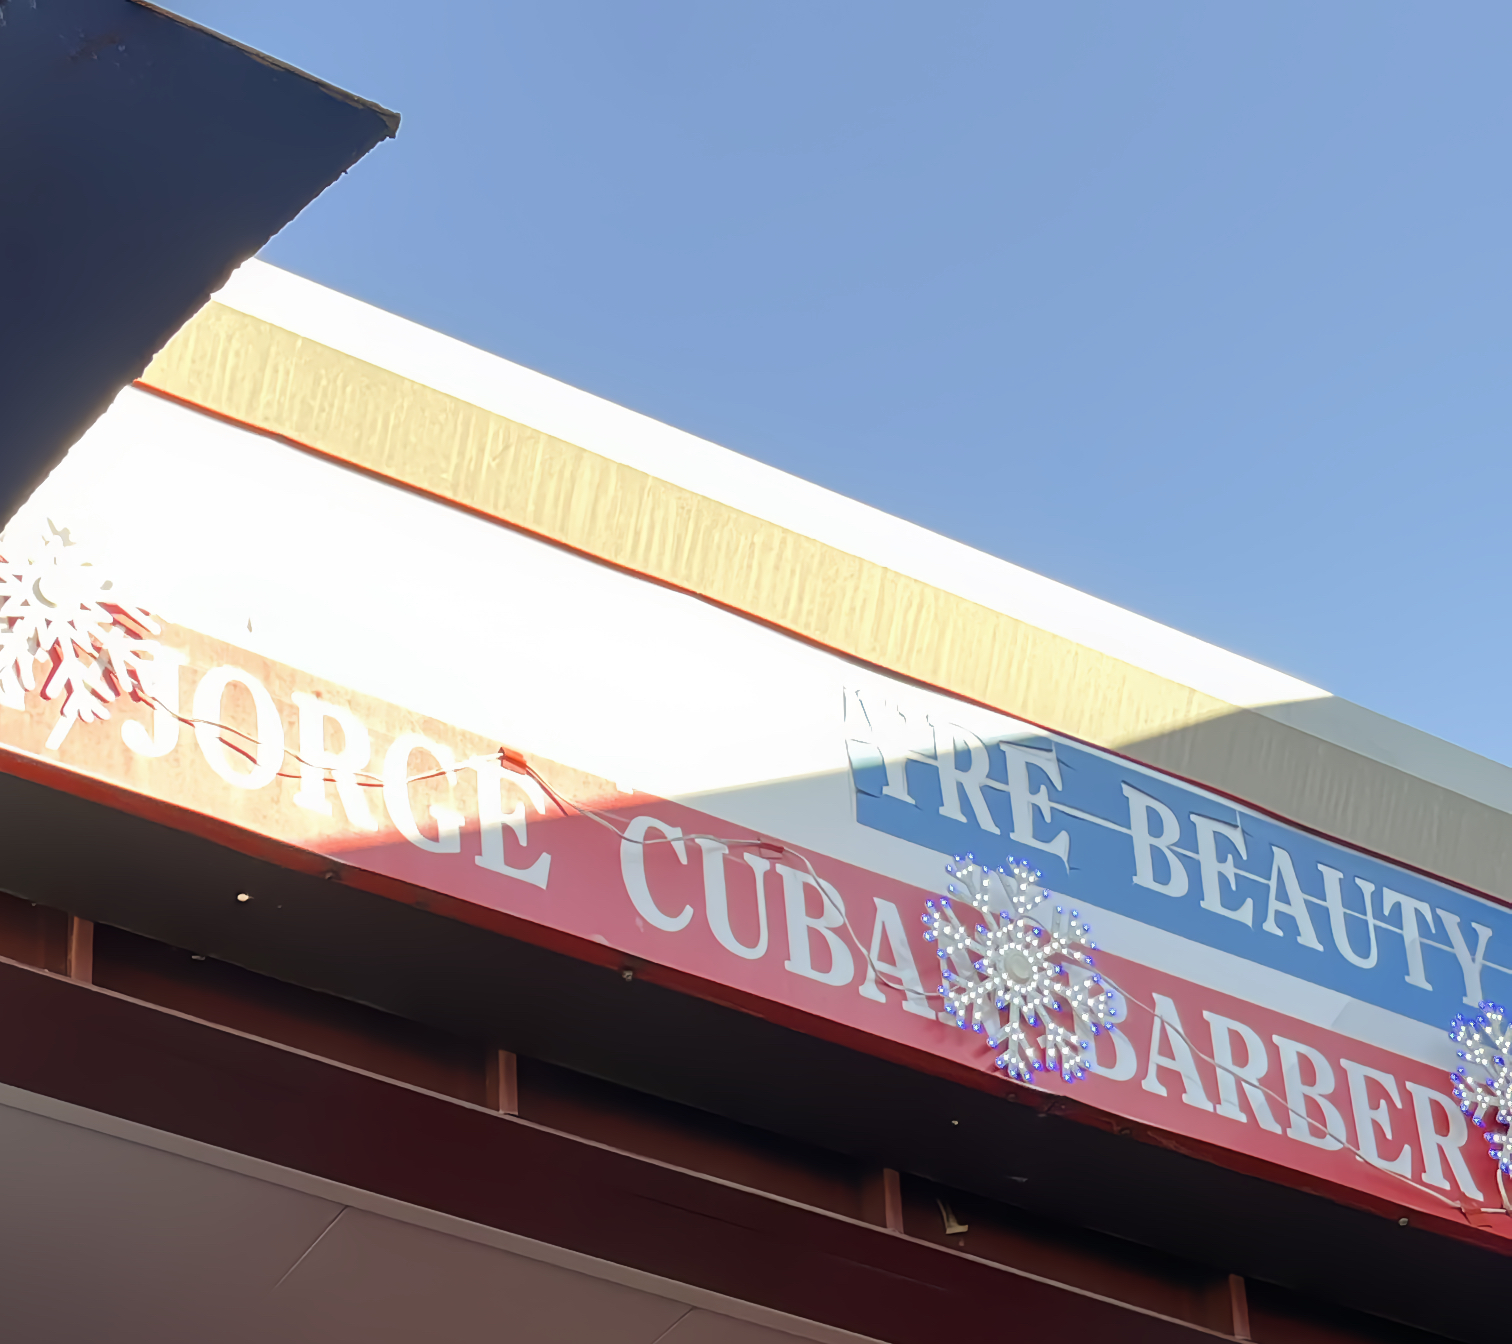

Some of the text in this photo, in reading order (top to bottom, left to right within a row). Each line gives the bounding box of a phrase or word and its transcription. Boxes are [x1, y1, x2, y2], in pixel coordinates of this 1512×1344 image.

[121, 640, 552, 890] JORGE
[1036, 960, 1484, 1202] BARBER
[1120, 780, 1493, 1008] BEAUTY
